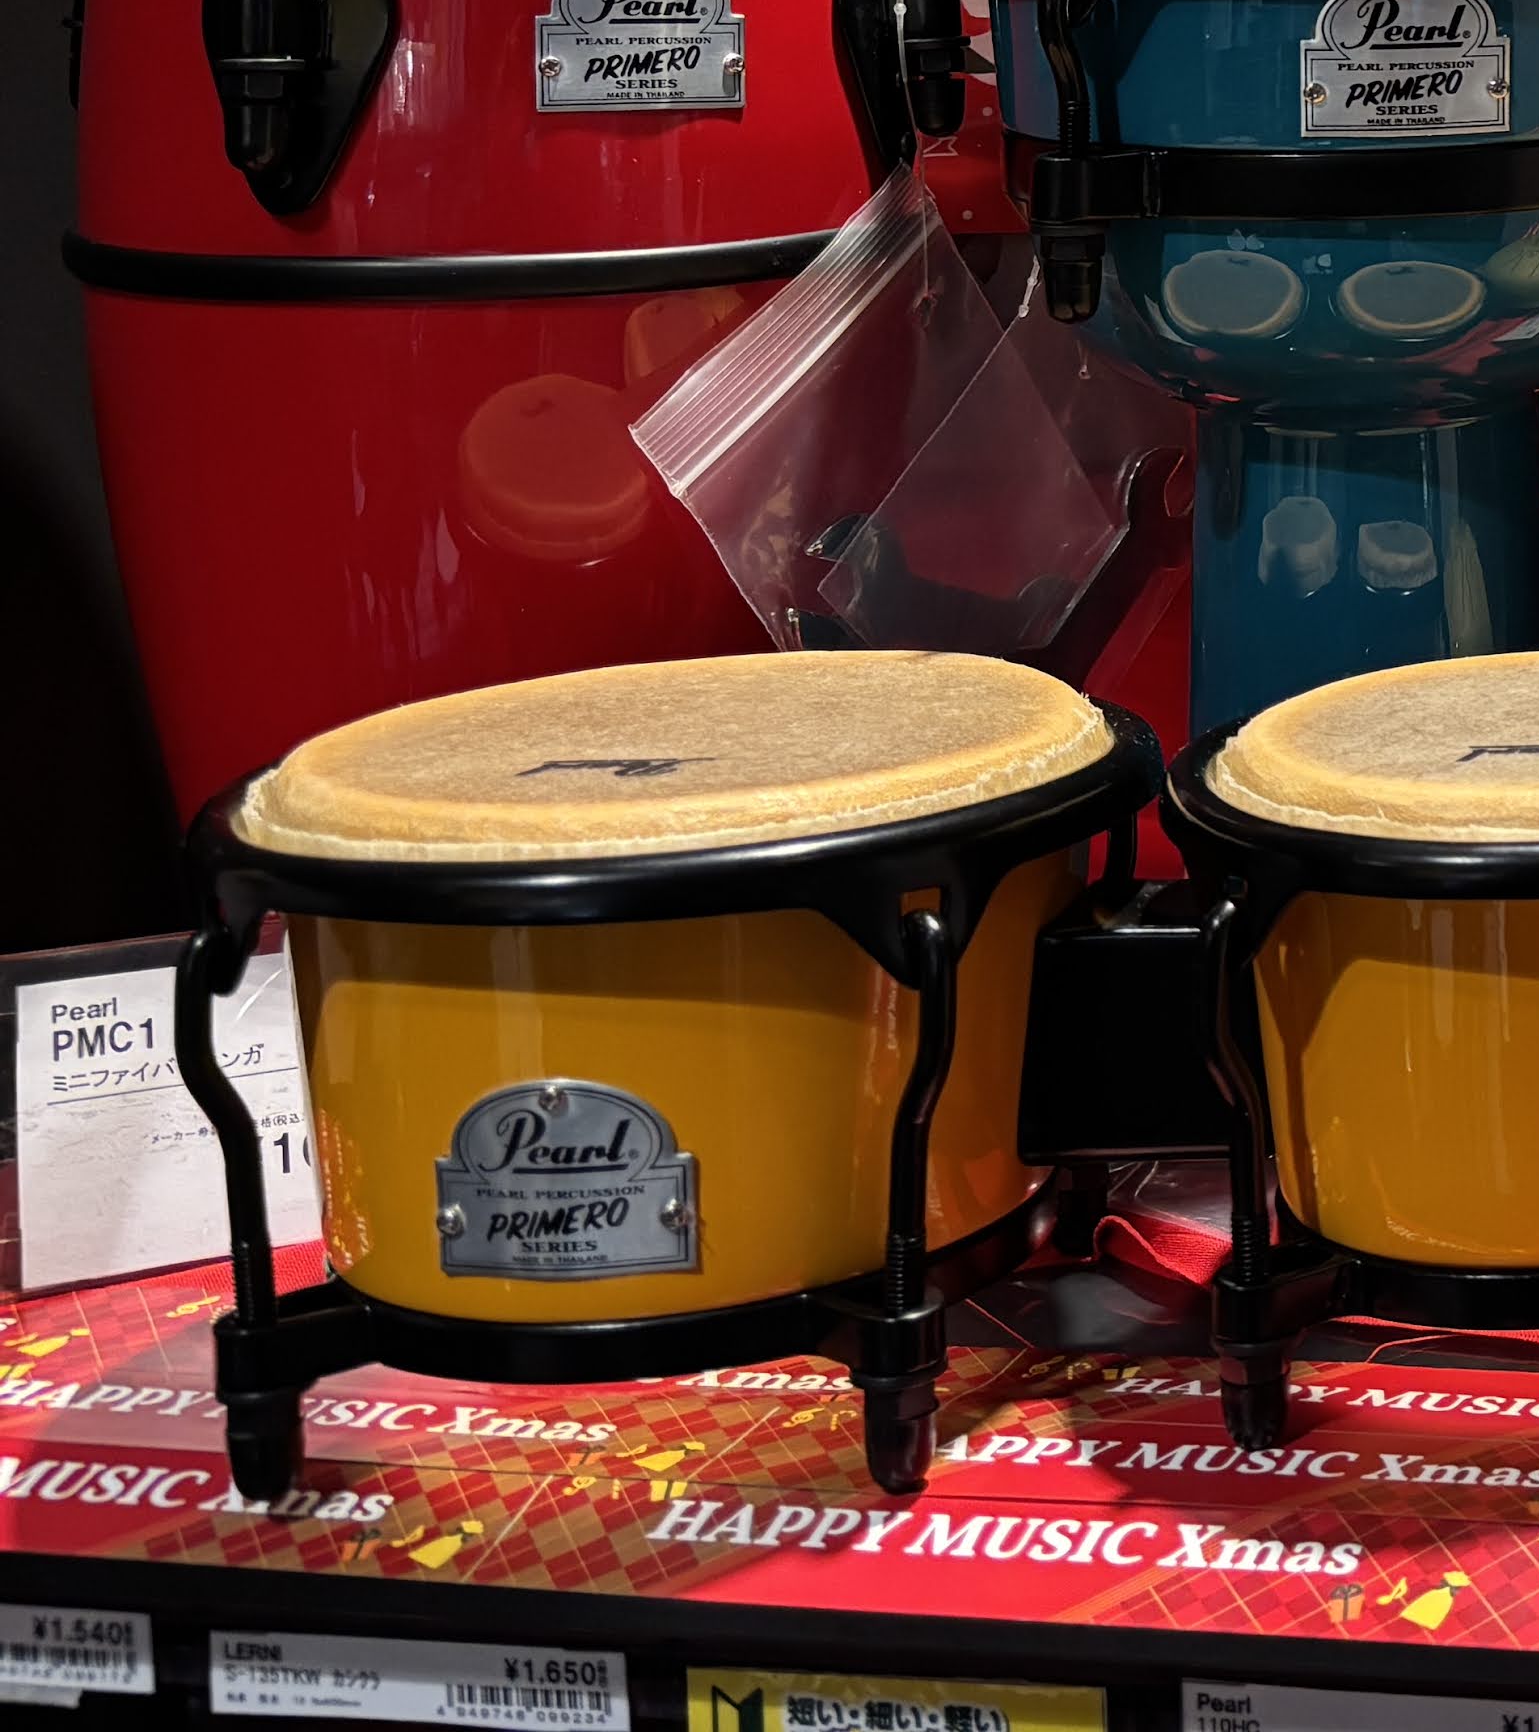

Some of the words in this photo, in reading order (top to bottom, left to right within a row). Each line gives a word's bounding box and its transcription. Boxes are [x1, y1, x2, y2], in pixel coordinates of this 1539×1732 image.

[629, 36, 711, 46] PERCUSSION
[584, 45, 700, 82] PRIMERO
[1390, 60, 1475, 71] PERCUSSION
[615, 79, 678, 90] SERIES
[1346, 69, 1463, 108] PRIMERO
[1376, 105, 1438, 116] SERIES
[51, 997, 118, 1024] Pearl
[53, 1018, 154, 1061] PMC1
[478, 1109, 632, 1174] Pearl
[486, 1197, 630, 1242] PRIMERO
[522, 1240, 598, 1253] SERIES
[677, 1368, 853, 1392] Xmas
[0, 1377, 211, 1417] HAPPY
[427, 1406, 617, 1443] Xmas
[1117, 1441, 1361, 1479] MUSIC
[0, 1456, 211, 1508] MUSIC
[647, 1499, 912, 1553] HAPPY
[903, 1513, 1156, 1565] MUSIC
[1157, 1524, 1363, 1576] Xmas
[1197, 1692, 1251, 1715] Pearl
